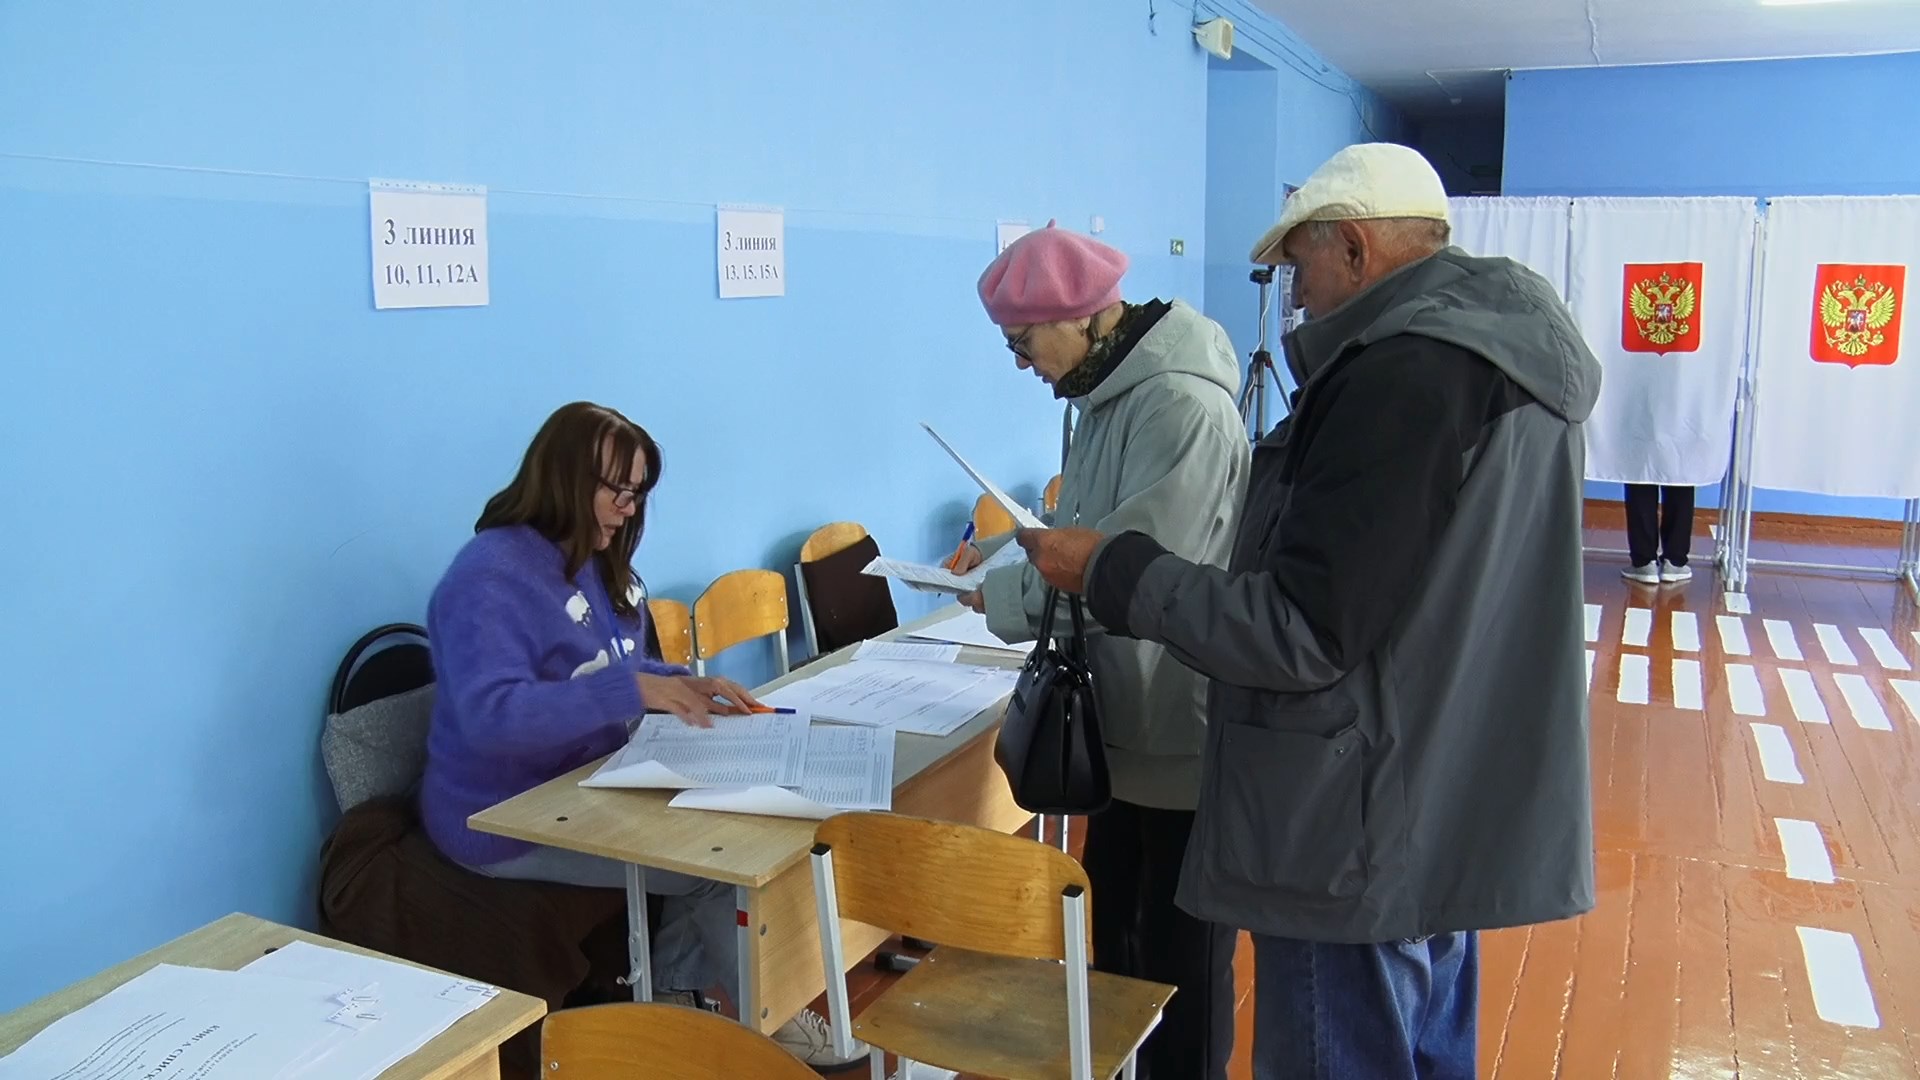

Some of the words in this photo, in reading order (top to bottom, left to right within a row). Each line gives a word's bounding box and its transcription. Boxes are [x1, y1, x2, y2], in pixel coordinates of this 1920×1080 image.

[384, 218, 396, 245] 3
[403, 226, 476, 246] линия
[724, 231, 732, 251] 3
[735, 237, 777, 251] линия
[385, 263, 411, 288] 10,
[416, 263, 441, 288] 11,
[447, 263, 479, 284] 12А
[760, 264, 779, 280] 15А
[140, 1047, 184, 1080] СПИСК
